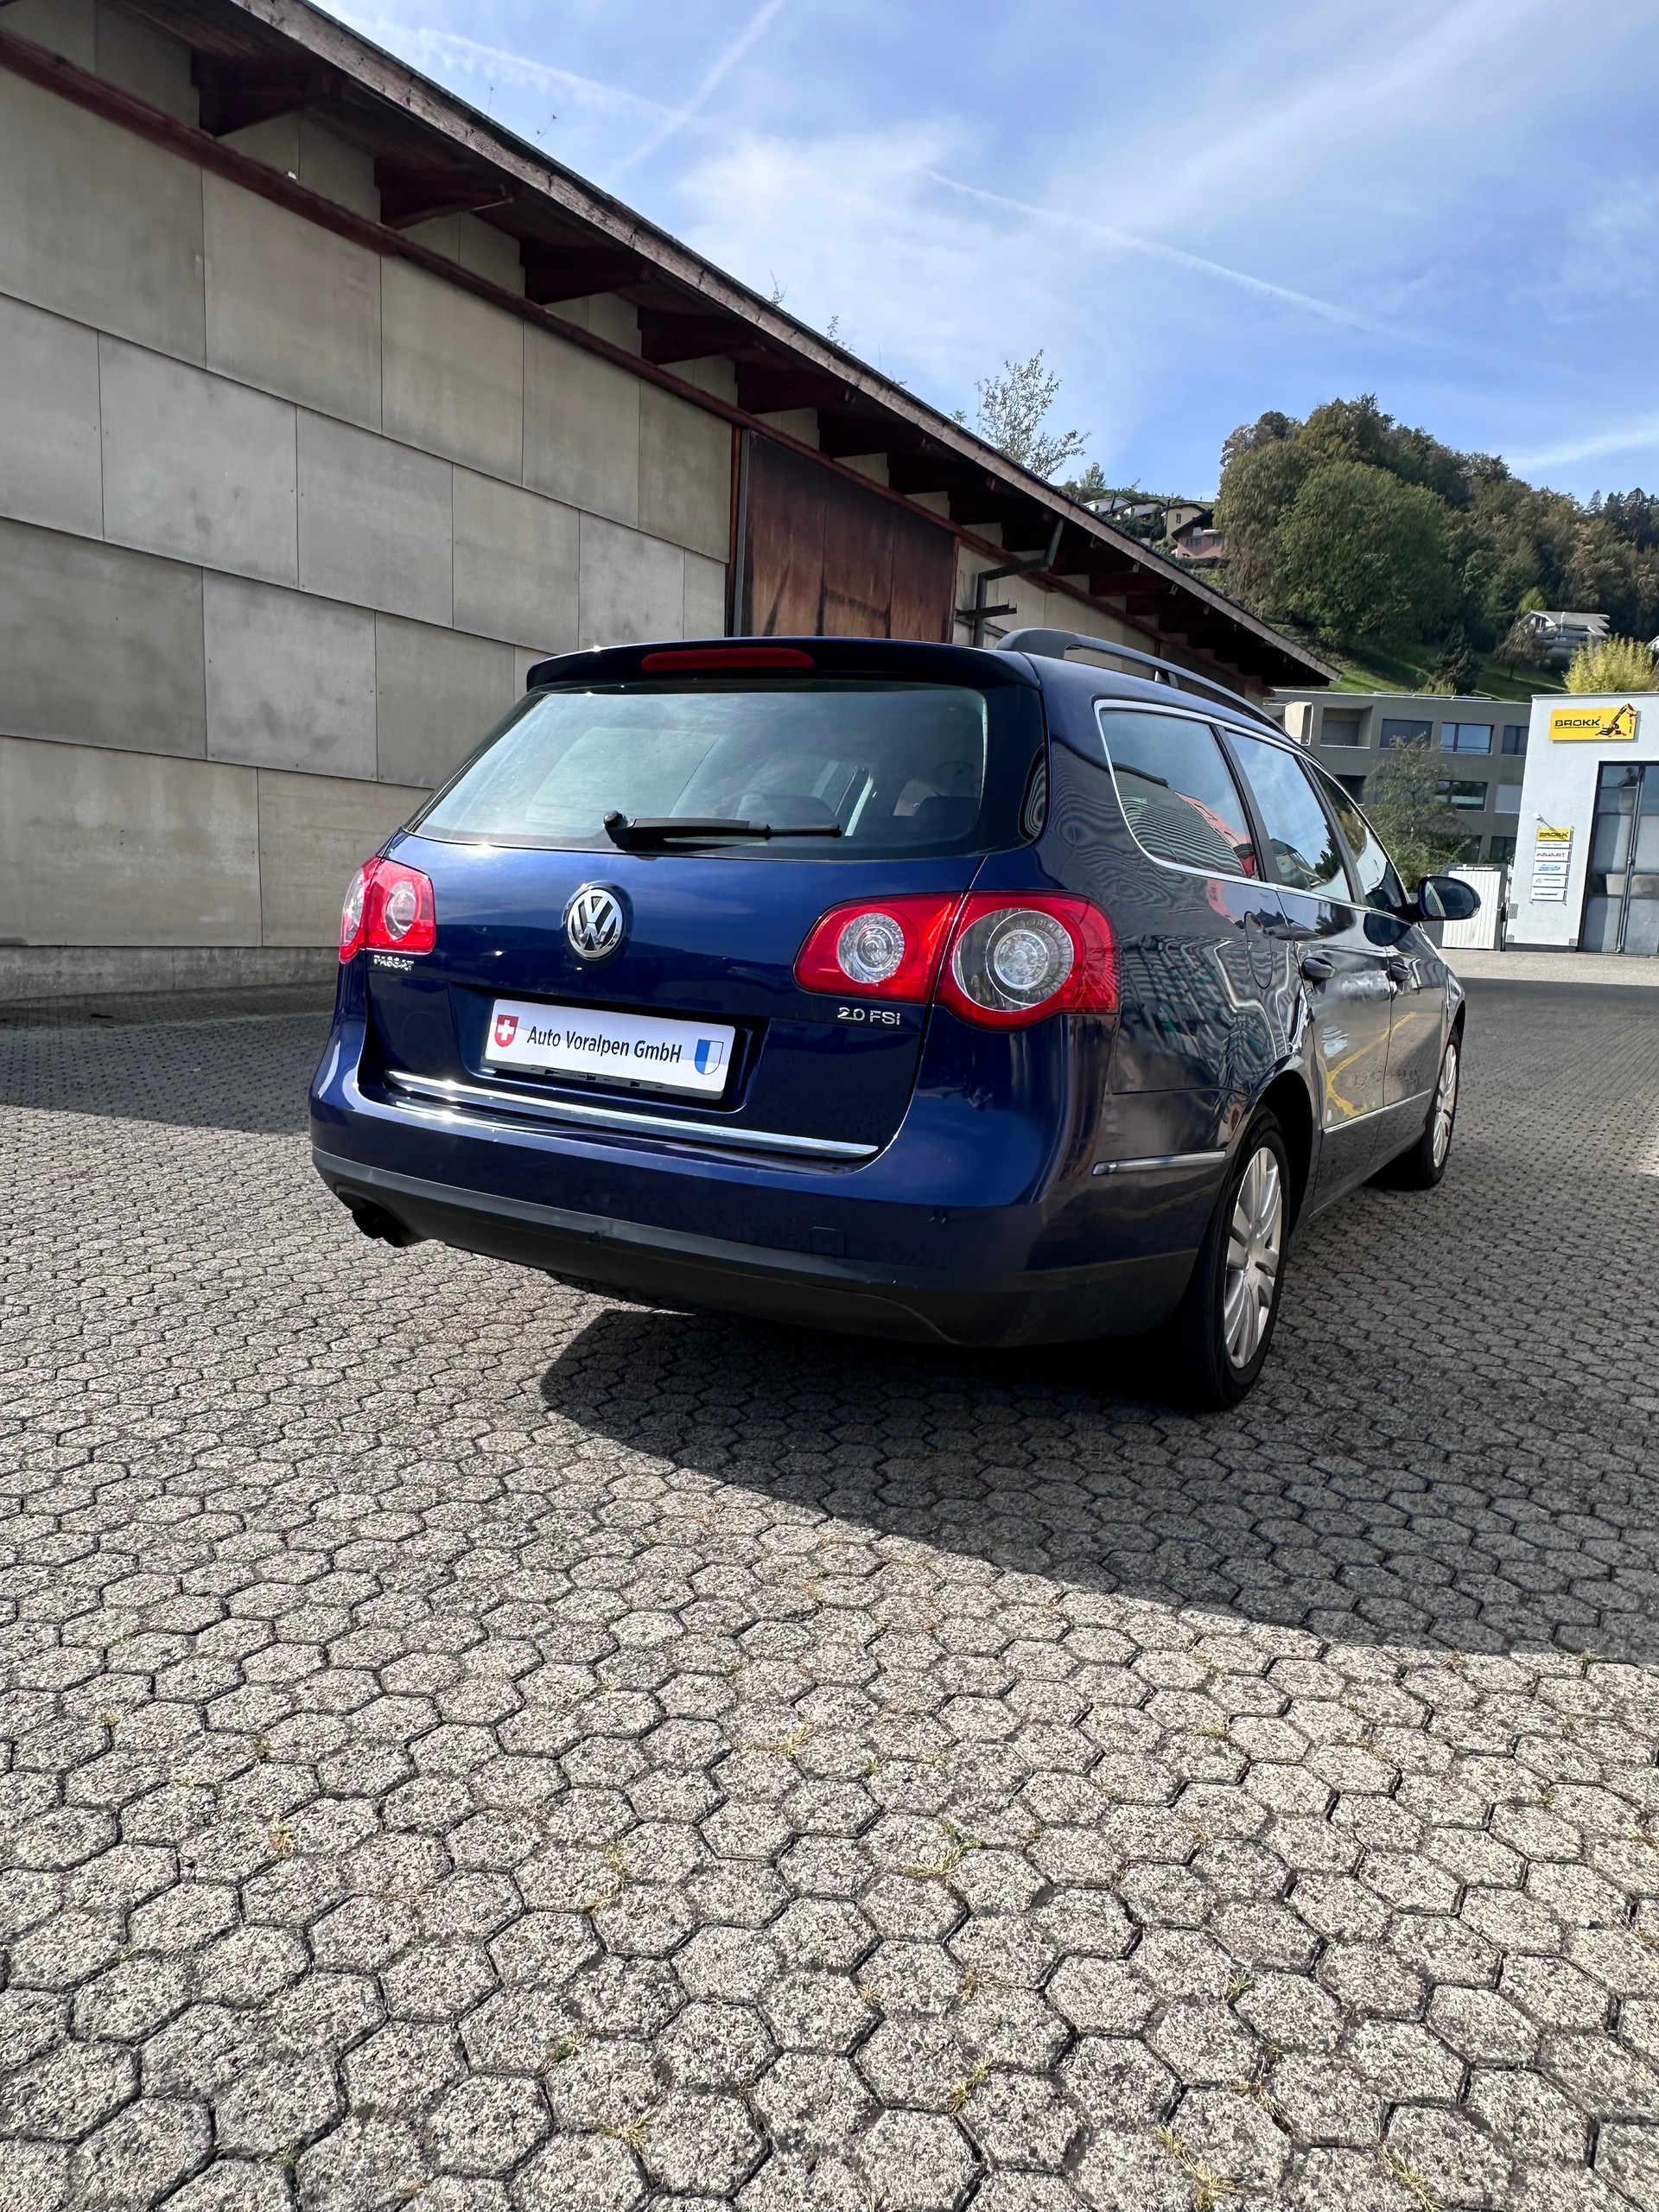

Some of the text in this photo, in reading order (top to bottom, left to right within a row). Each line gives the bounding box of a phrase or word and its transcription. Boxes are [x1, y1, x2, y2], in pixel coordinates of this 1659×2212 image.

[1554, 719, 1600, 728] BROKK
[568, 888, 622, 959] VW
[869, 1009, 901, 1026] FSI
[526, 1026, 683, 1064] Auto Voralpen GmbH
